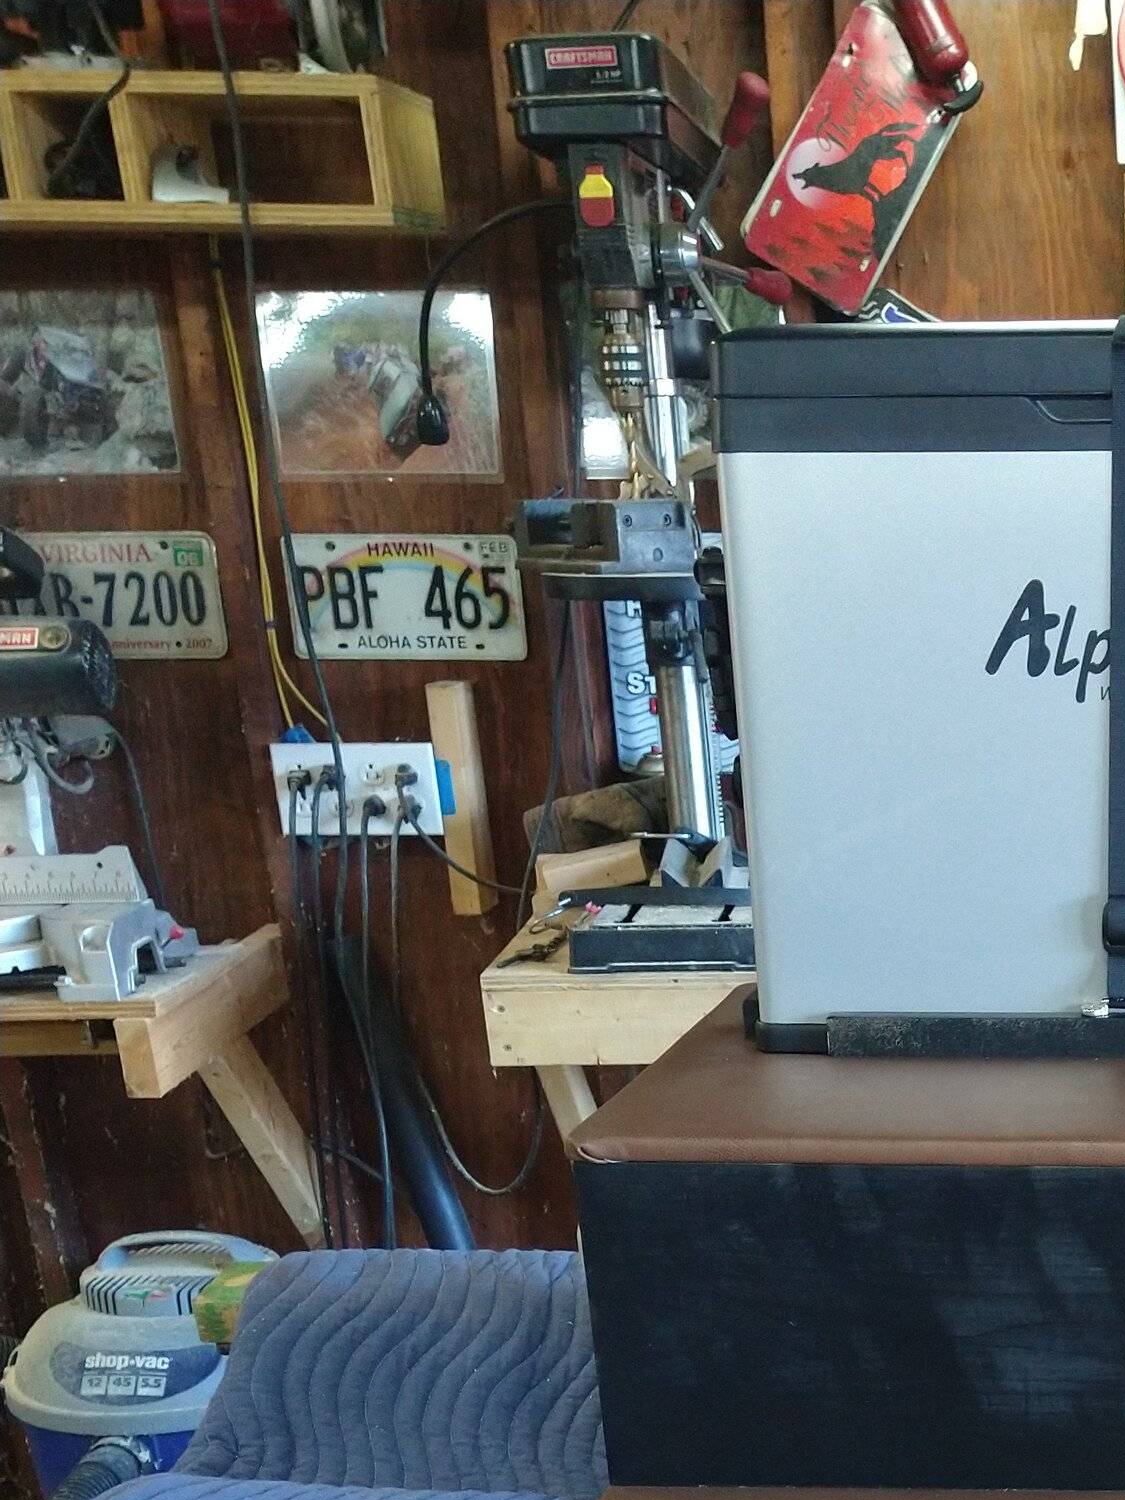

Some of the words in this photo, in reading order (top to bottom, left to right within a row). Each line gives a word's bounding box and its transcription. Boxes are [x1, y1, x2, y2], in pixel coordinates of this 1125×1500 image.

[39, 543, 153, 563] VIRGINIA
[366, 541, 435, 558] HAWAII
[0, 569, 207, 629] R-7200
[297, 564, 385, 632] PBF
[424, 564, 511, 631] 465
[358, 635, 411, 650] ALOHA
[416, 634, 468, 650] STATE
